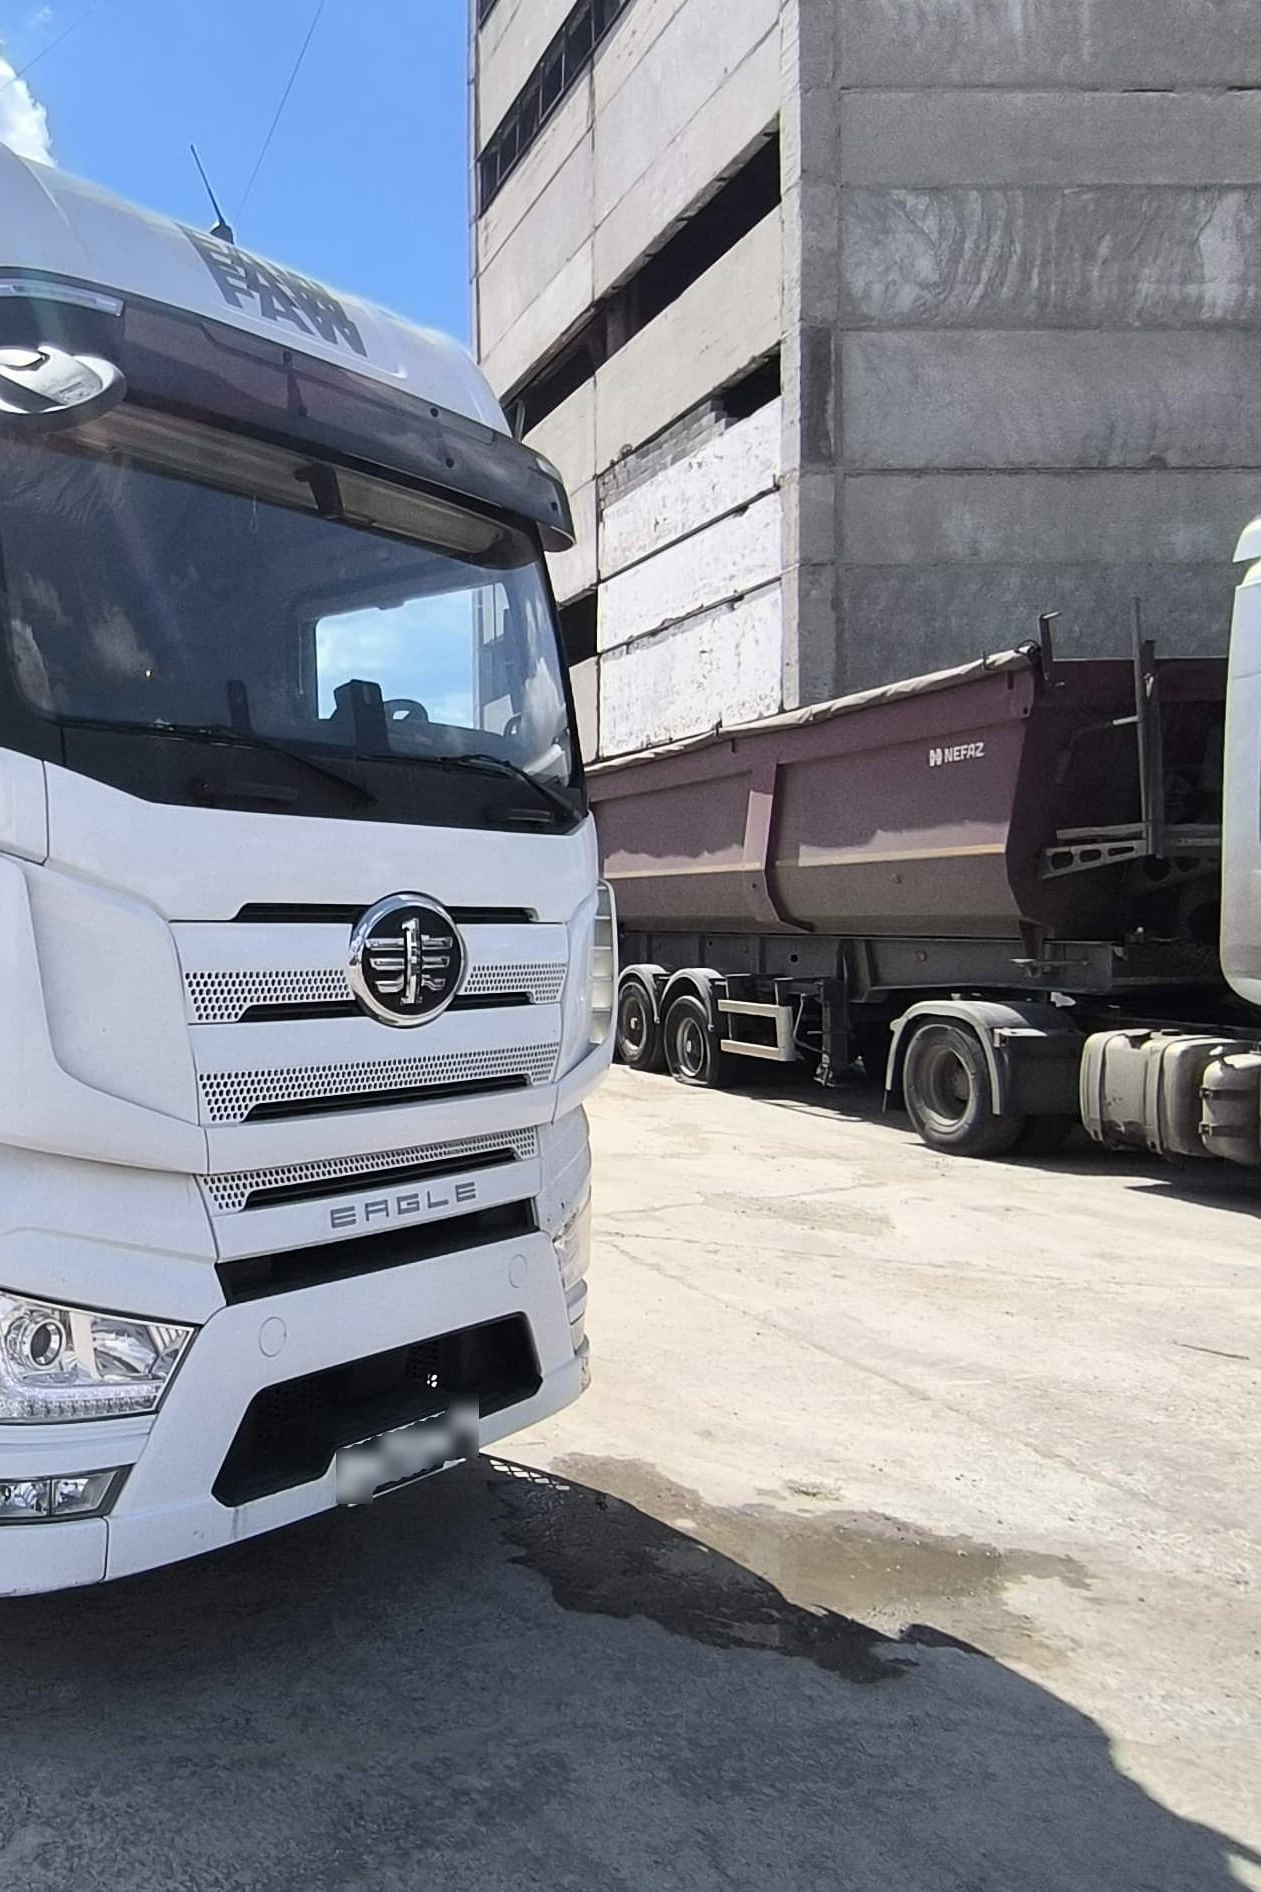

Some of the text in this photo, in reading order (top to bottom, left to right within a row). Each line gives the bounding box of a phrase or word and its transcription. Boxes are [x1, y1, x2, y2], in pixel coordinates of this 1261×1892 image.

[184, 236, 368, 357] FAW
[944, 742, 985, 763] NEFAZ
[330, 1182, 476, 1229] EAGLE
